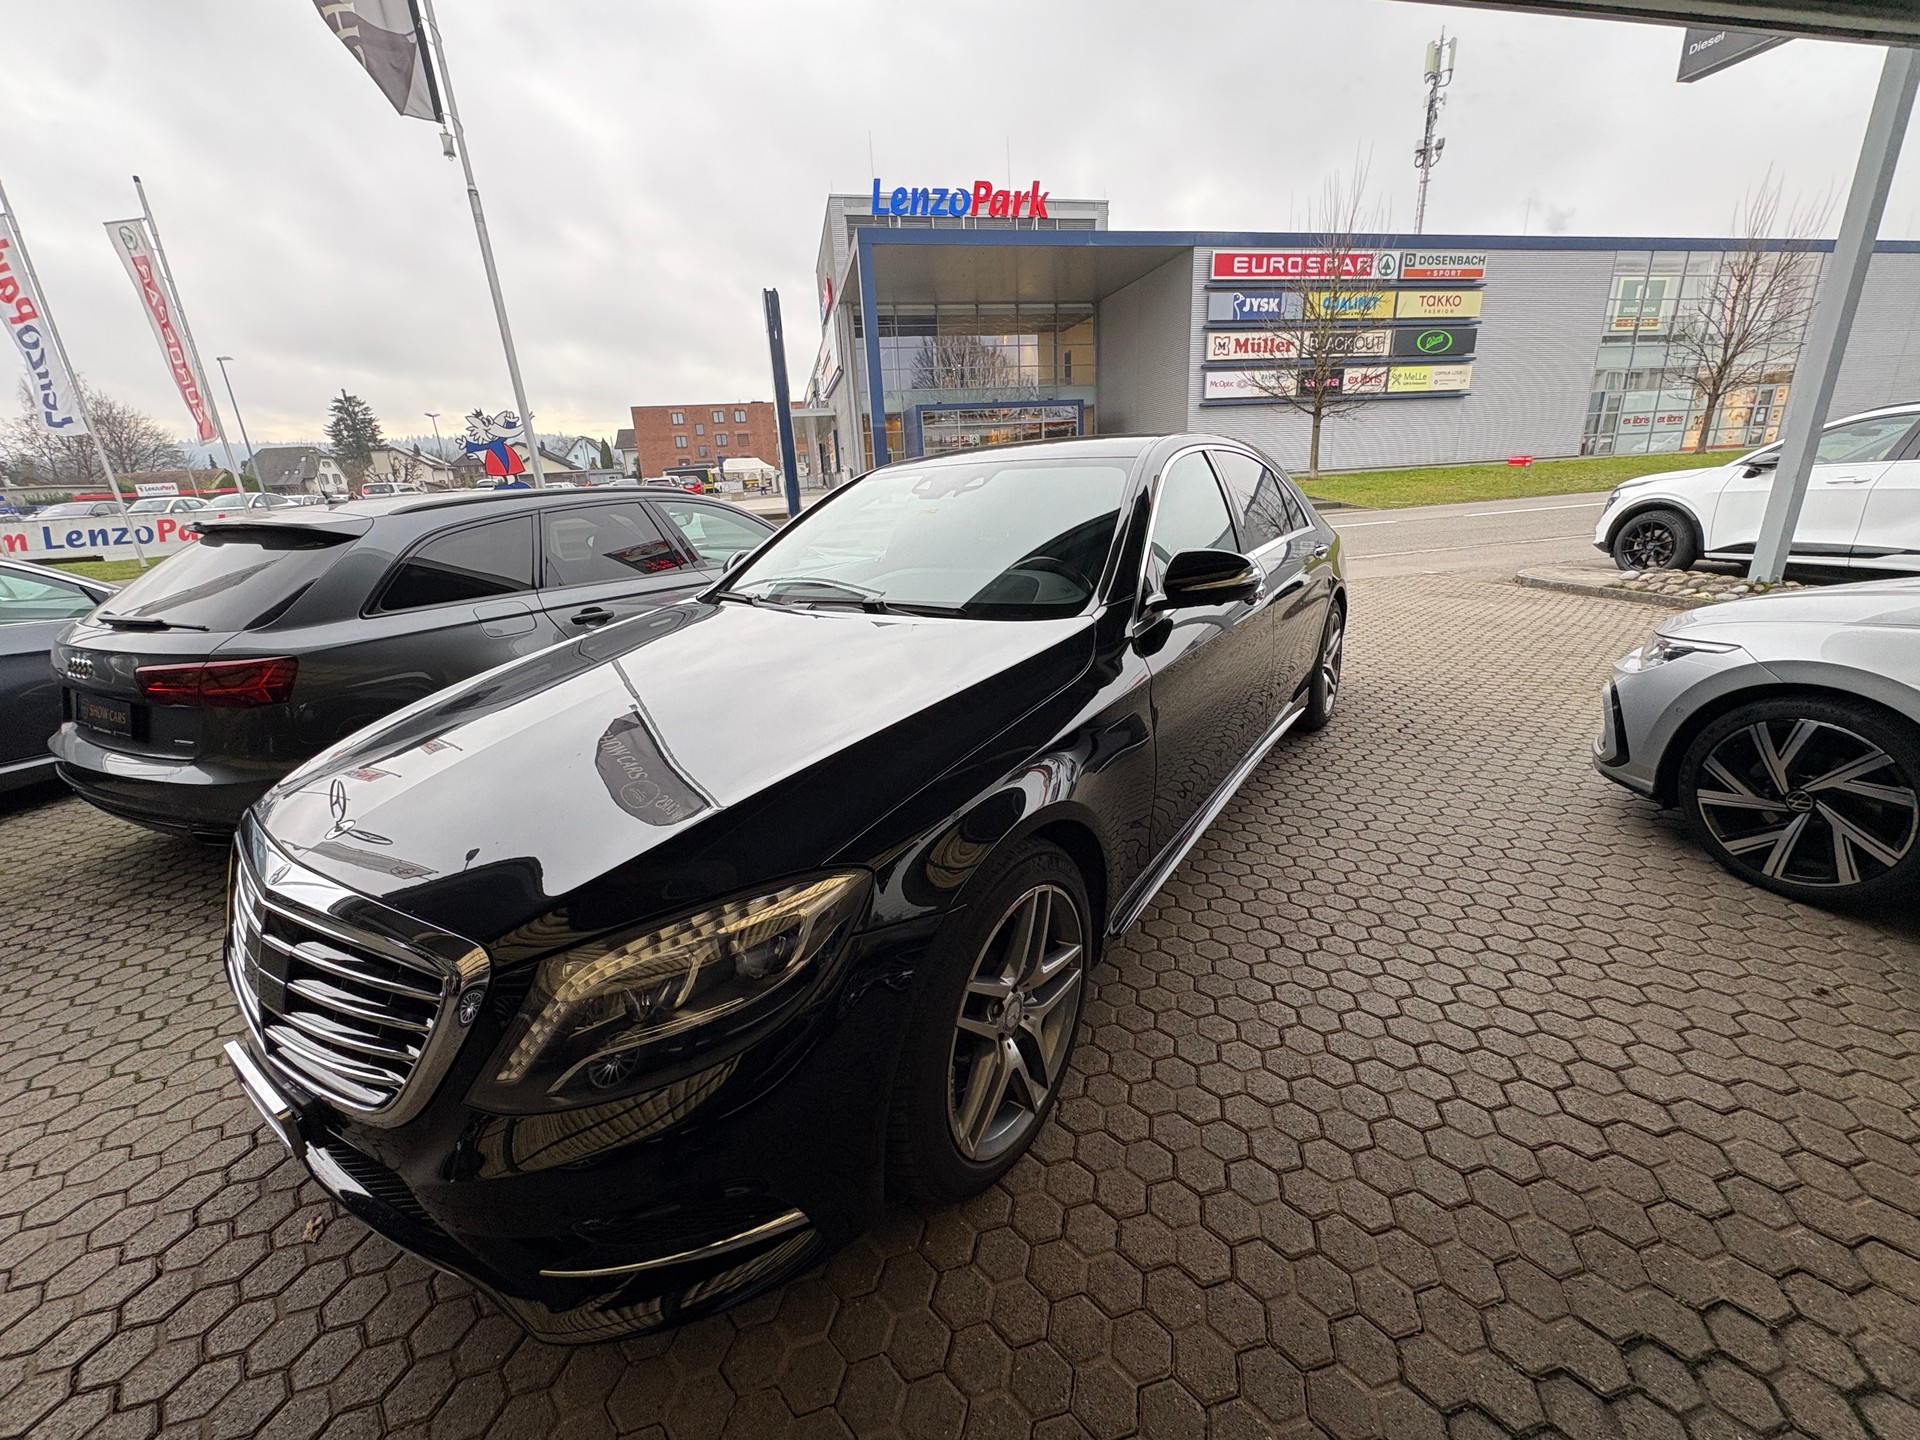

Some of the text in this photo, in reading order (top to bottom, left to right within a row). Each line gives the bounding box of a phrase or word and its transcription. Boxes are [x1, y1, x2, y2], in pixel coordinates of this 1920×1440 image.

[1689, 31, 1725, 55] Diesel
[871, 178, 1050, 219] LenzoPark
[1233, 256, 1371, 273] EUROSPAR
[1418, 255, 1486, 266] DOSENBACH
[1242, 297, 1280, 313] JYSK
[1233, 336, 1294, 354] Müller
[1348, 376, 1359, 385] ex
[1623, 415, 1650, 425] ex libris
[1657, 416, 1665, 424] ex
[1666, 414, 1683, 423] libris
[144, 484, 175, 492] LenzoPark
[42, 515, 225, 551] LenzoPa
[109, 709, 127, 724] CARS
